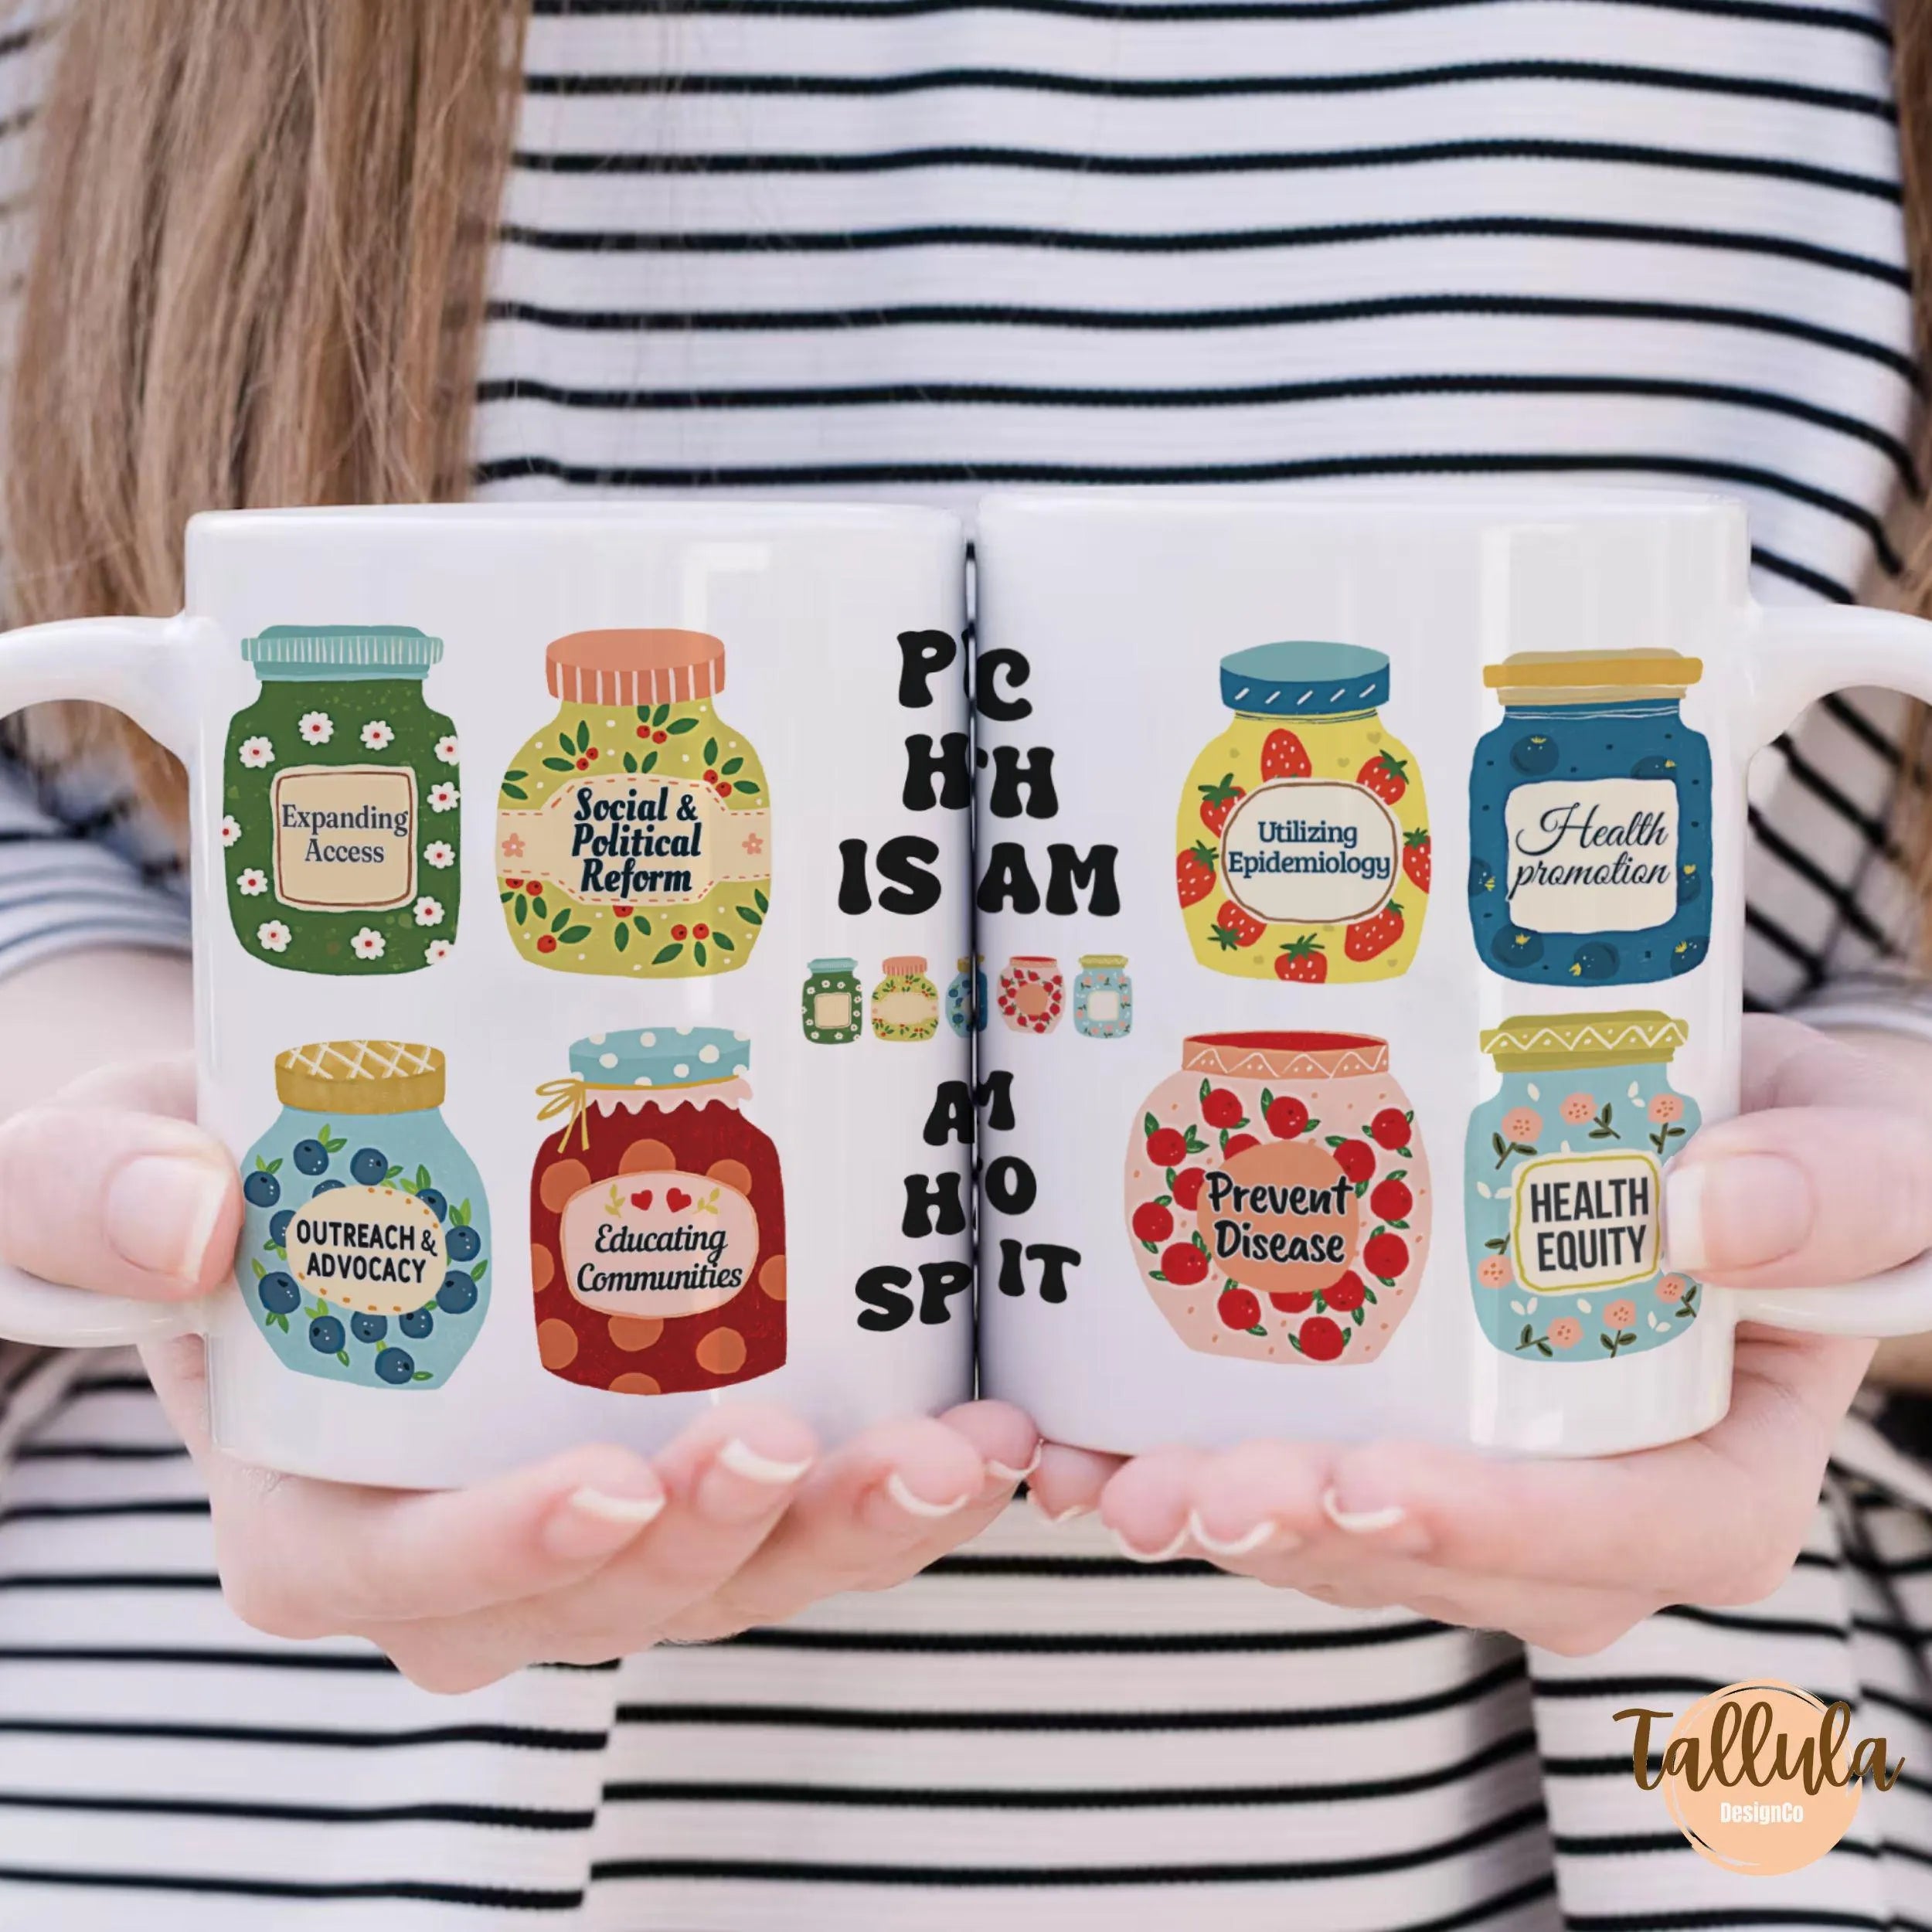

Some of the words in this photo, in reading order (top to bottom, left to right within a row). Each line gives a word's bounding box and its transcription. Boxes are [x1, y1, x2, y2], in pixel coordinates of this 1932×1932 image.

[281, 804, 409, 836] Expanding
[573, 787, 668, 821] Social
[676, 794, 699, 821] &
[571, 821, 702, 859] Political
[1257, 820, 1358, 848] Utilizing
[1515, 802, 1668, 857] Health
[304, 838, 384, 863] Access
[1227, 851, 1391, 880] Epidemiology
[580, 858, 692, 899] Reform
[838, 835, 941, 915] IS
[977, 842, 1121, 917] AM
[1509, 851, 1671, 900] promotion
[1206, 1171, 1354, 1216] Prevent
[1530, 1176, 1649, 1223] HEALTH
[297, 1219, 415, 1248] OUTREACH
[420, 1229, 438, 1257] &
[594, 1223, 728, 1263] Educating
[1215, 1219, 1345, 1264] Disease
[1537, 1224, 1647, 1272] EQUITY
[306, 1252, 427, 1284] ADVOCACY
[577, 1261, 743, 1293] Communities
[998, 1239, 1081, 1304] IT
[855, 1261, 973, 1332] SP
